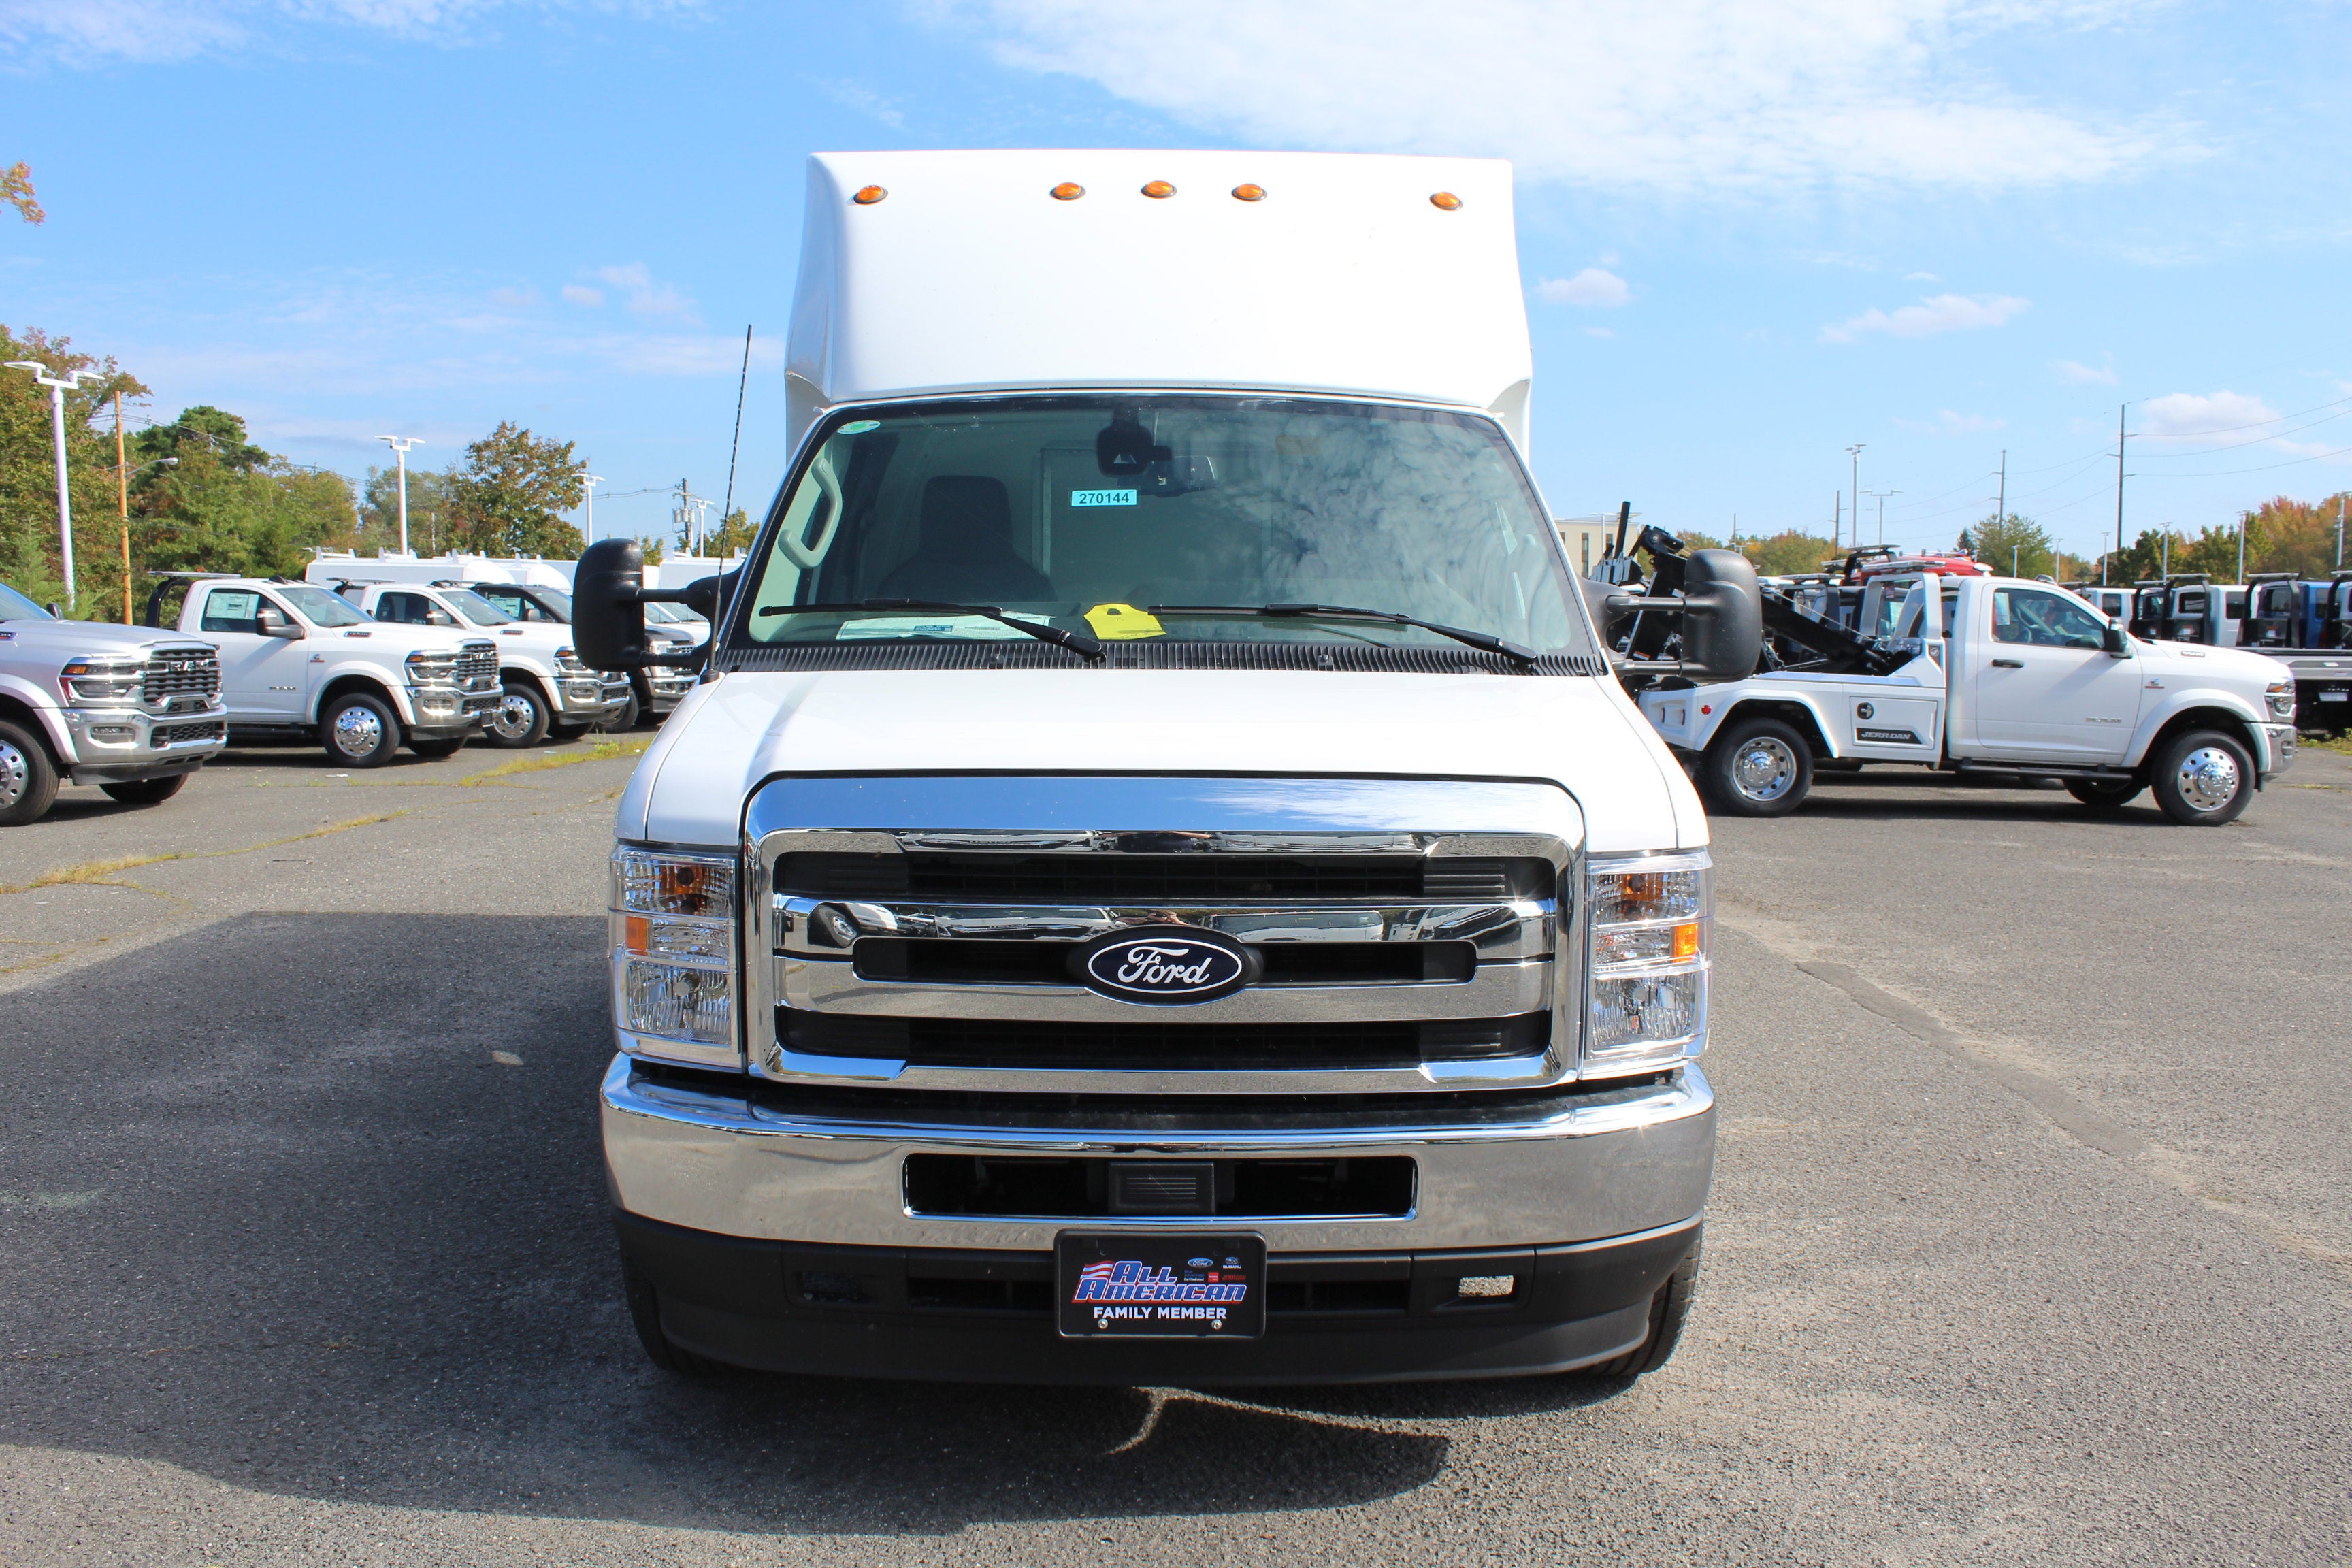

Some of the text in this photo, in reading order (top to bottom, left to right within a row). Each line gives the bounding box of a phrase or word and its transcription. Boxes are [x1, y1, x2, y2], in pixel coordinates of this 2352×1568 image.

[1079, 493, 1130, 504] 270144
[1117, 946, 1213, 984] Ford
[1094, 1307, 1227, 1319] FAMILY MEMBER
